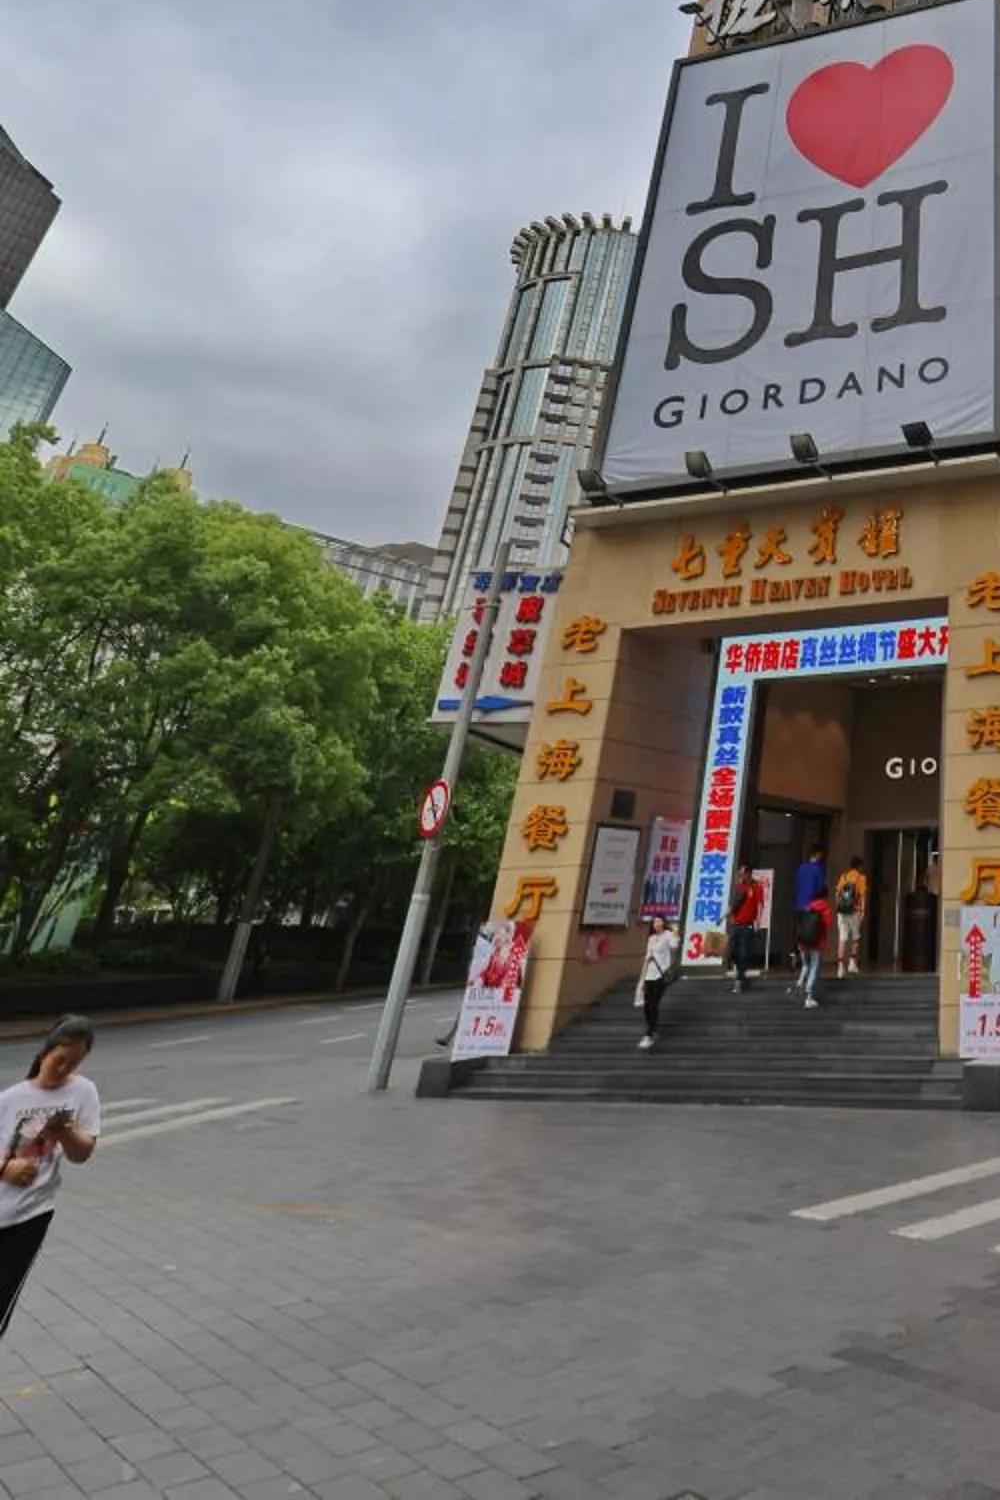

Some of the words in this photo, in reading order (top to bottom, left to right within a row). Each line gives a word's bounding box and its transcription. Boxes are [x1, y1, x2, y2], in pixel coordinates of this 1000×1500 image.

[685, 82, 771, 216] I
[663, 179, 949, 370] SH
[652, 356, 950, 429] GIORDANO
[838, 566, 914, 596] HOTEL
[504, 614, 607, 921] 老上海餐厅
[885, 756, 938, 779] GIO
